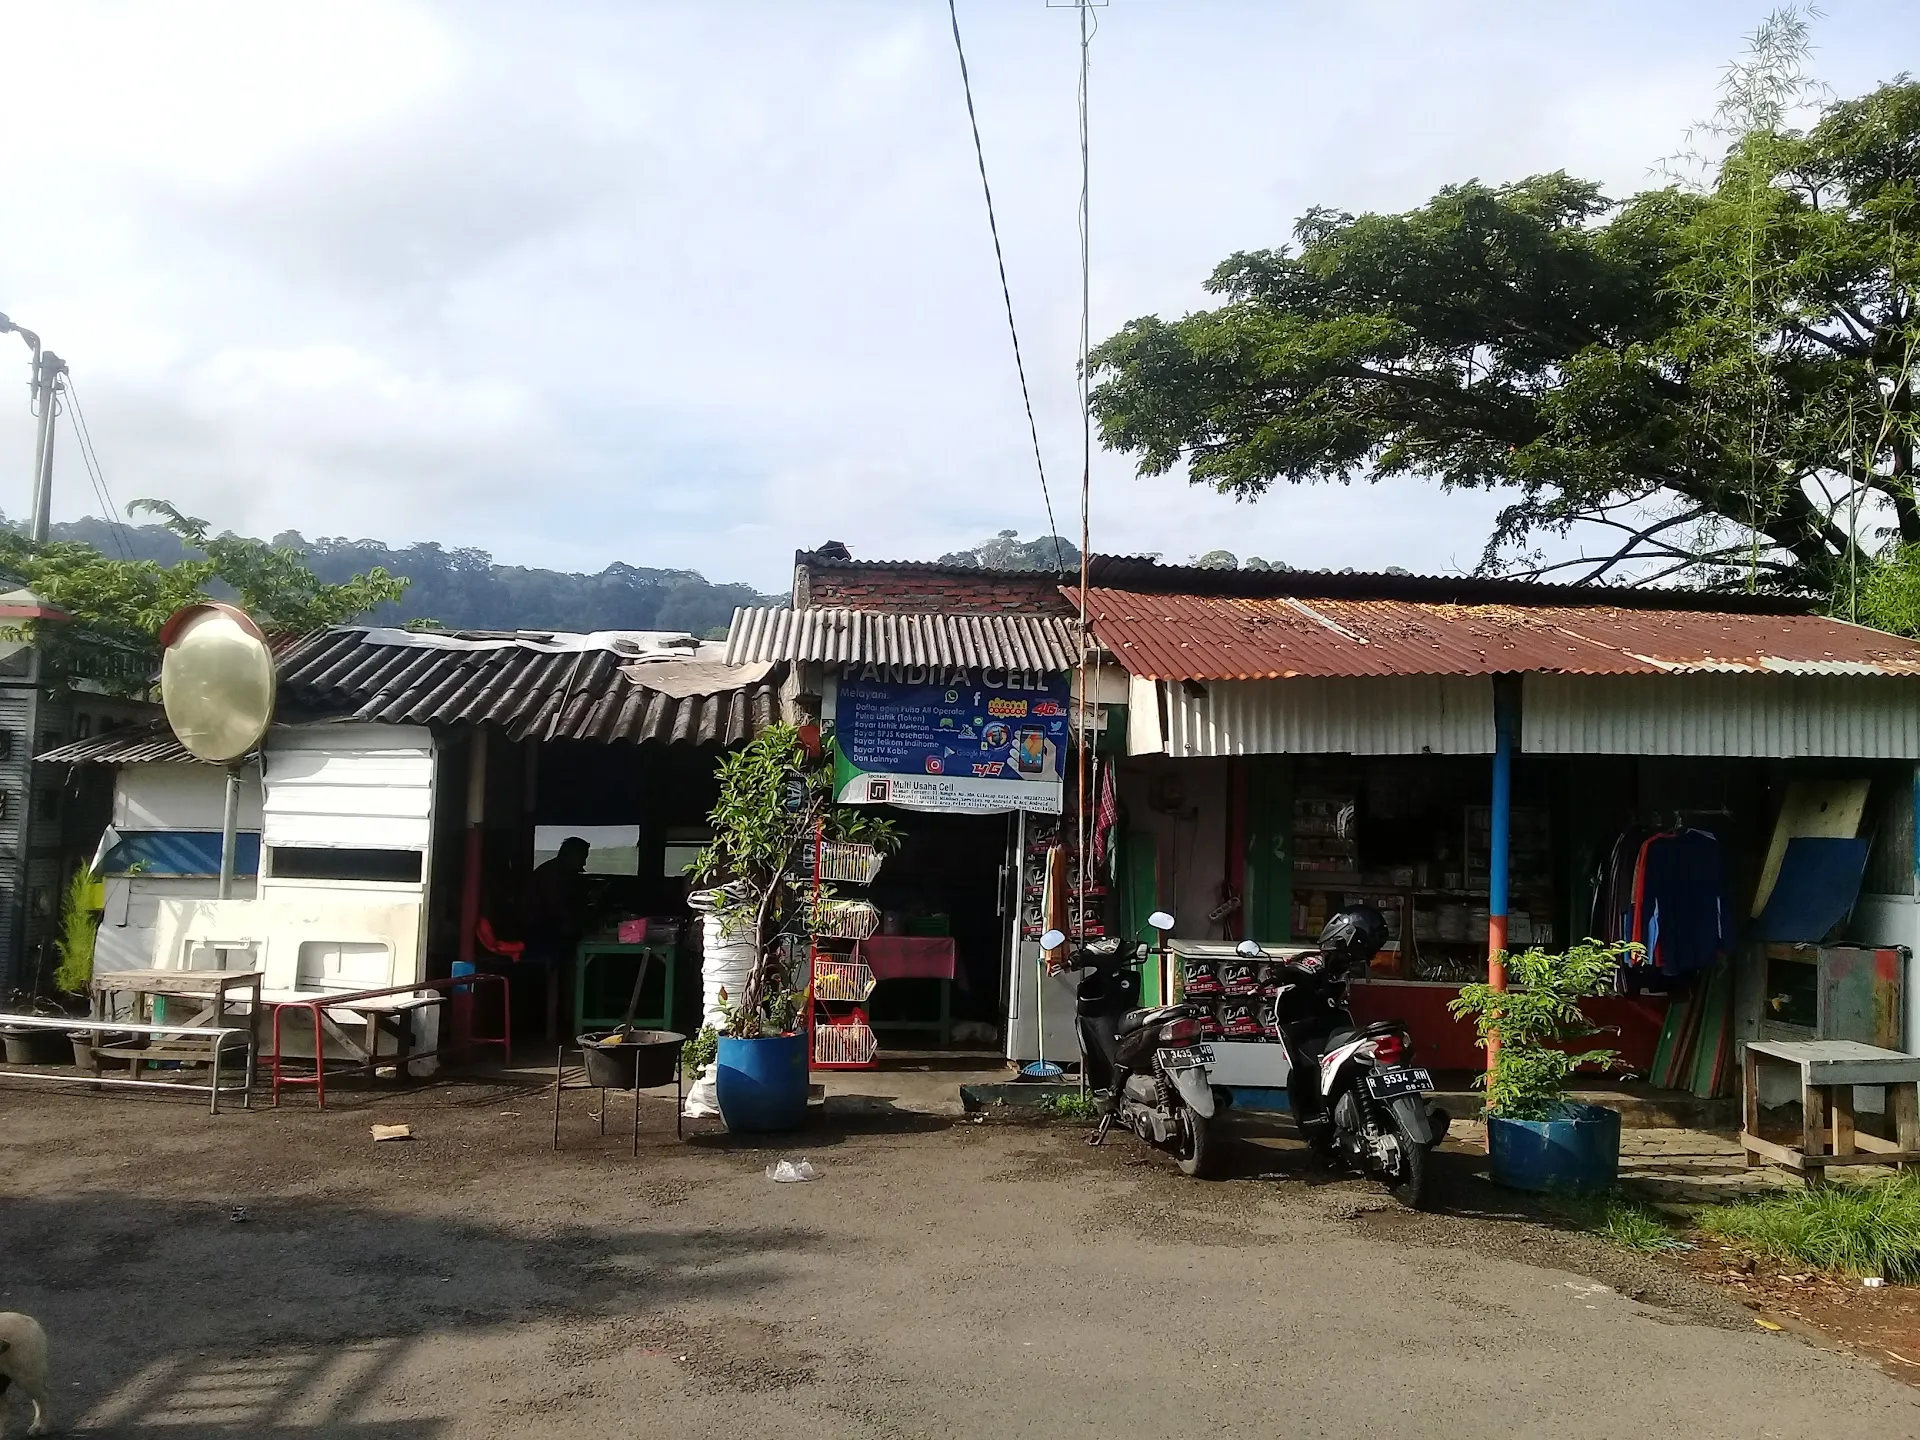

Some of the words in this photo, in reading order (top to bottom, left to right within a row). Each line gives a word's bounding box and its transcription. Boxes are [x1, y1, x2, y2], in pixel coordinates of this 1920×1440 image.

[982, 666, 1049, 692] CELL
[901, 706, 920, 714] Pulsa
[933, 707, 966, 717] Operator
[897, 713, 926, 724] (Token)
[854, 721, 876, 730] Bayar
[899, 722, 930, 731] Meteran
[854, 729, 876, 738] Bayar
[877, 730, 894, 738] BPJS
[895, 731, 935, 740] Kesehatan
[853, 737, 876, 746] Bayar
[876, 738, 903, 746] Telkom
[853, 745, 875, 755] Bayar
[956, 749, 979, 759] Google
[869, 756, 899, 765] Lainnya
[893, 780, 912, 790] Multi
[913, 781, 937, 791] Usaha
[938, 782, 954, 792] Cell
[1187, 964, 1208, 979] LA
[1227, 966, 1248, 980] LA
[1226, 1006, 1247, 1020] LA
[1161, 1050, 1167, 1059] A
[1170, 1048, 1193, 1059] 3435
[1368, 1078, 1377, 1088] R
[1382, 1072, 1409, 1085] 5534
[1413, 1070, 1428, 1080] RH
